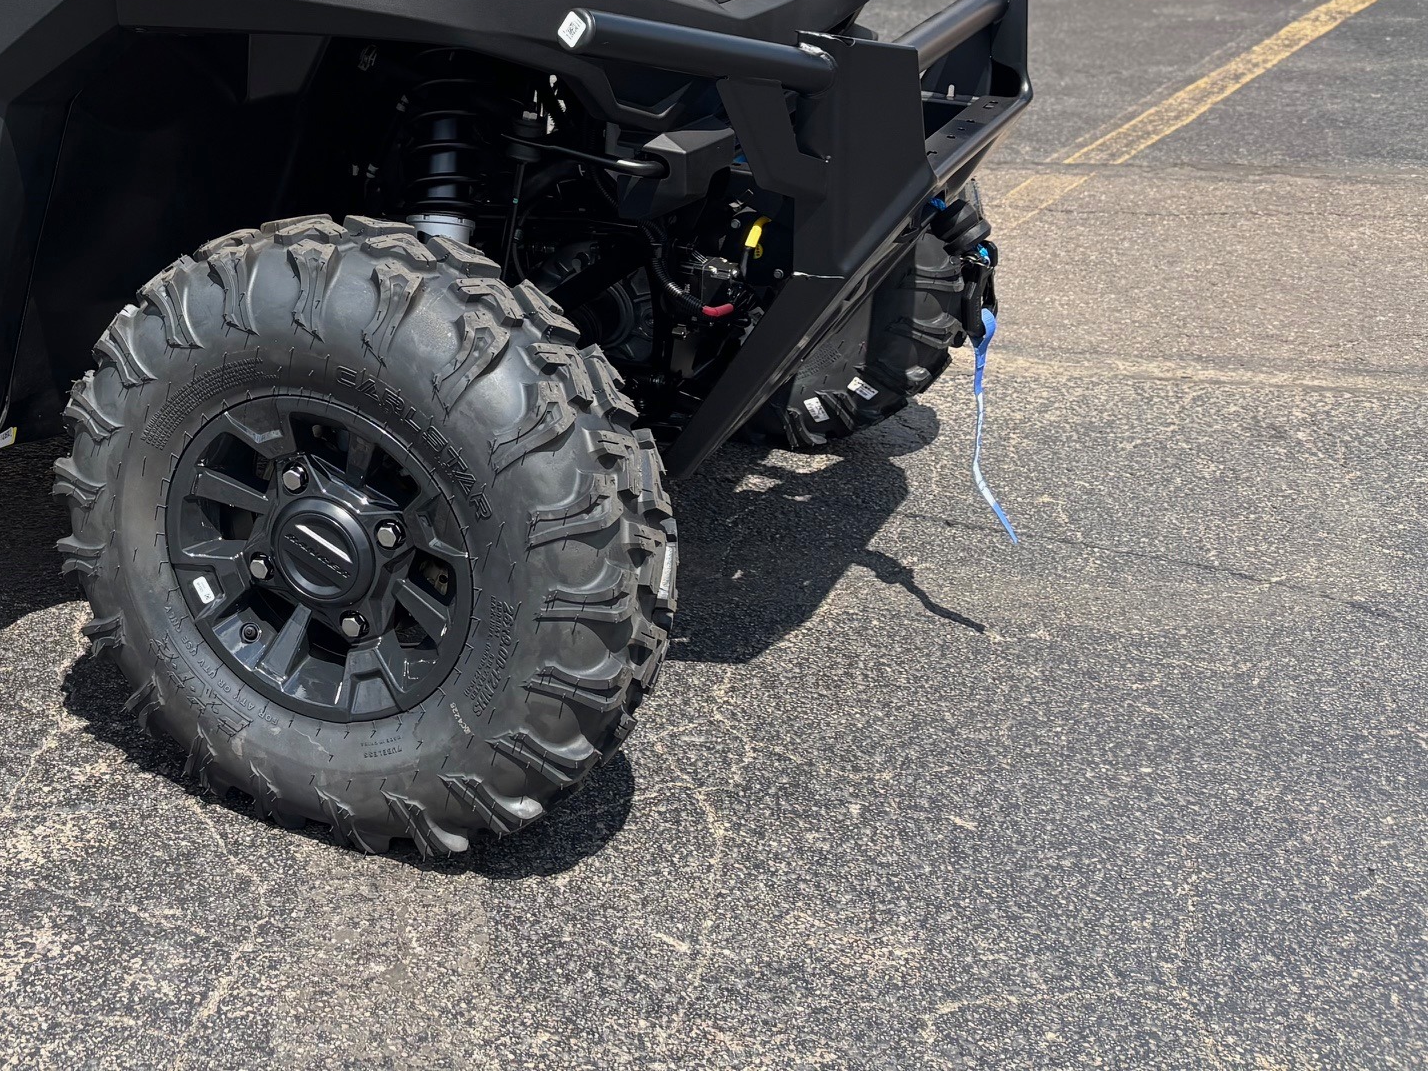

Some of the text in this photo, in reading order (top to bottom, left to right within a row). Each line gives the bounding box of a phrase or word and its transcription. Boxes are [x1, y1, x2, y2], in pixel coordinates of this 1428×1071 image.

[336, 365, 493, 522] CARLSTAR
[180, 635, 198, 657] USE
[196, 658, 217, 680] UTV
[216, 678, 232, 694] OR
[232, 692, 255, 712] ATV
[257, 709, 278, 726] FOR
[363, 745, 403, 759] TUBELESS
